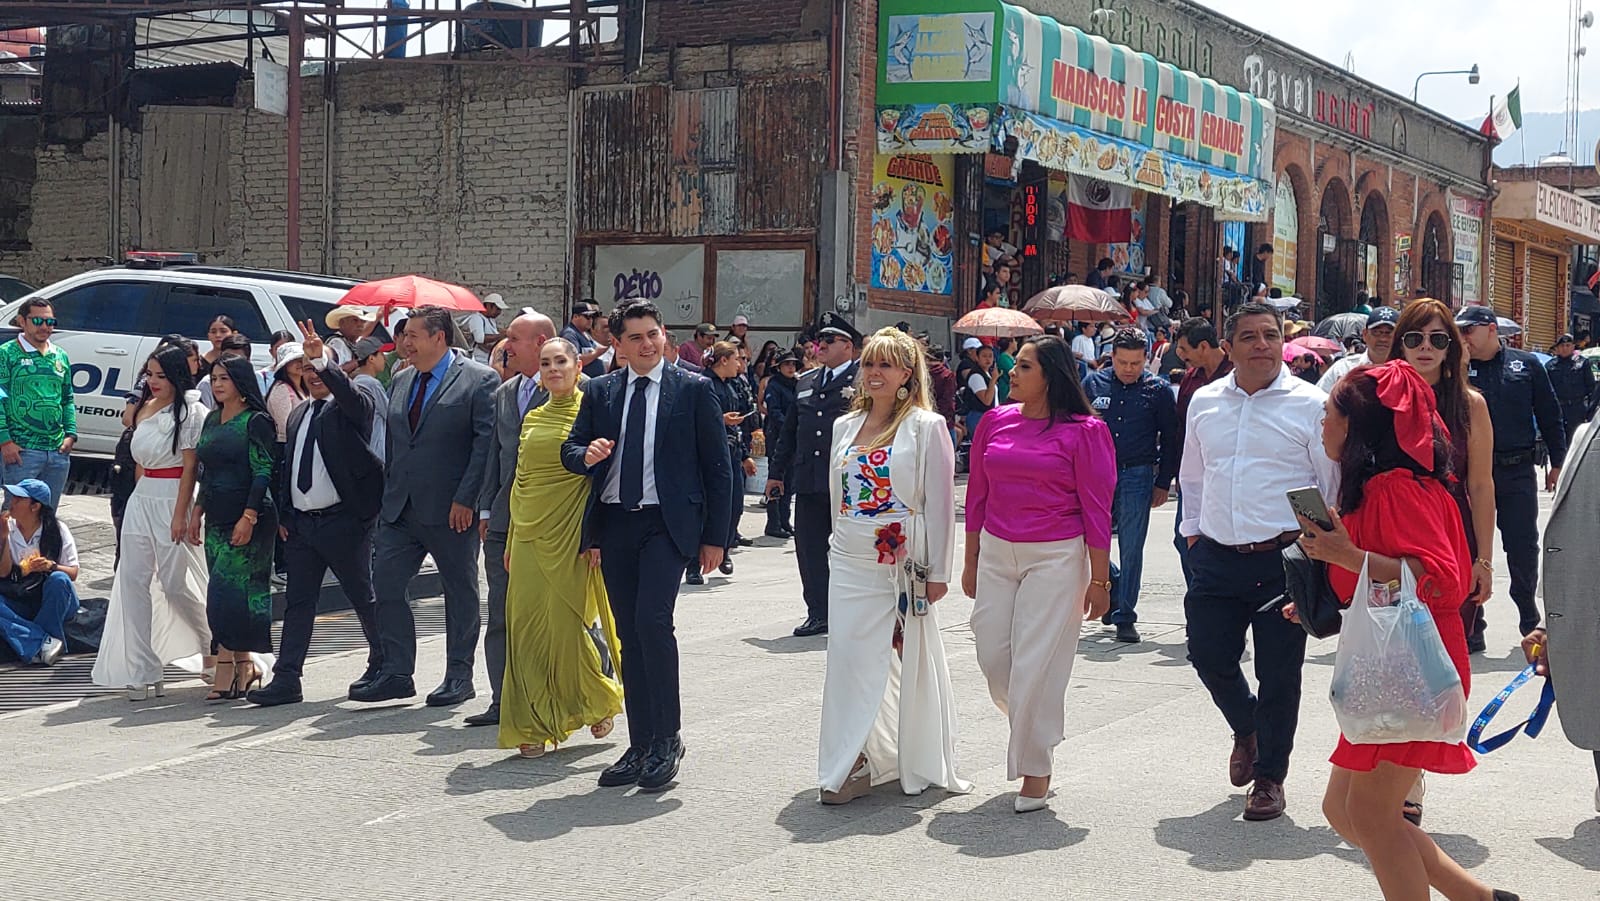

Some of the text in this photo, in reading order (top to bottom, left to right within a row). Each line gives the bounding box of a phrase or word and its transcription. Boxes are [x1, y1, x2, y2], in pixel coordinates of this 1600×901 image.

[1051, 58, 1245, 157] MARISCOS LA COSTA GRANDE
[886, 156, 943, 186] GRANDE
